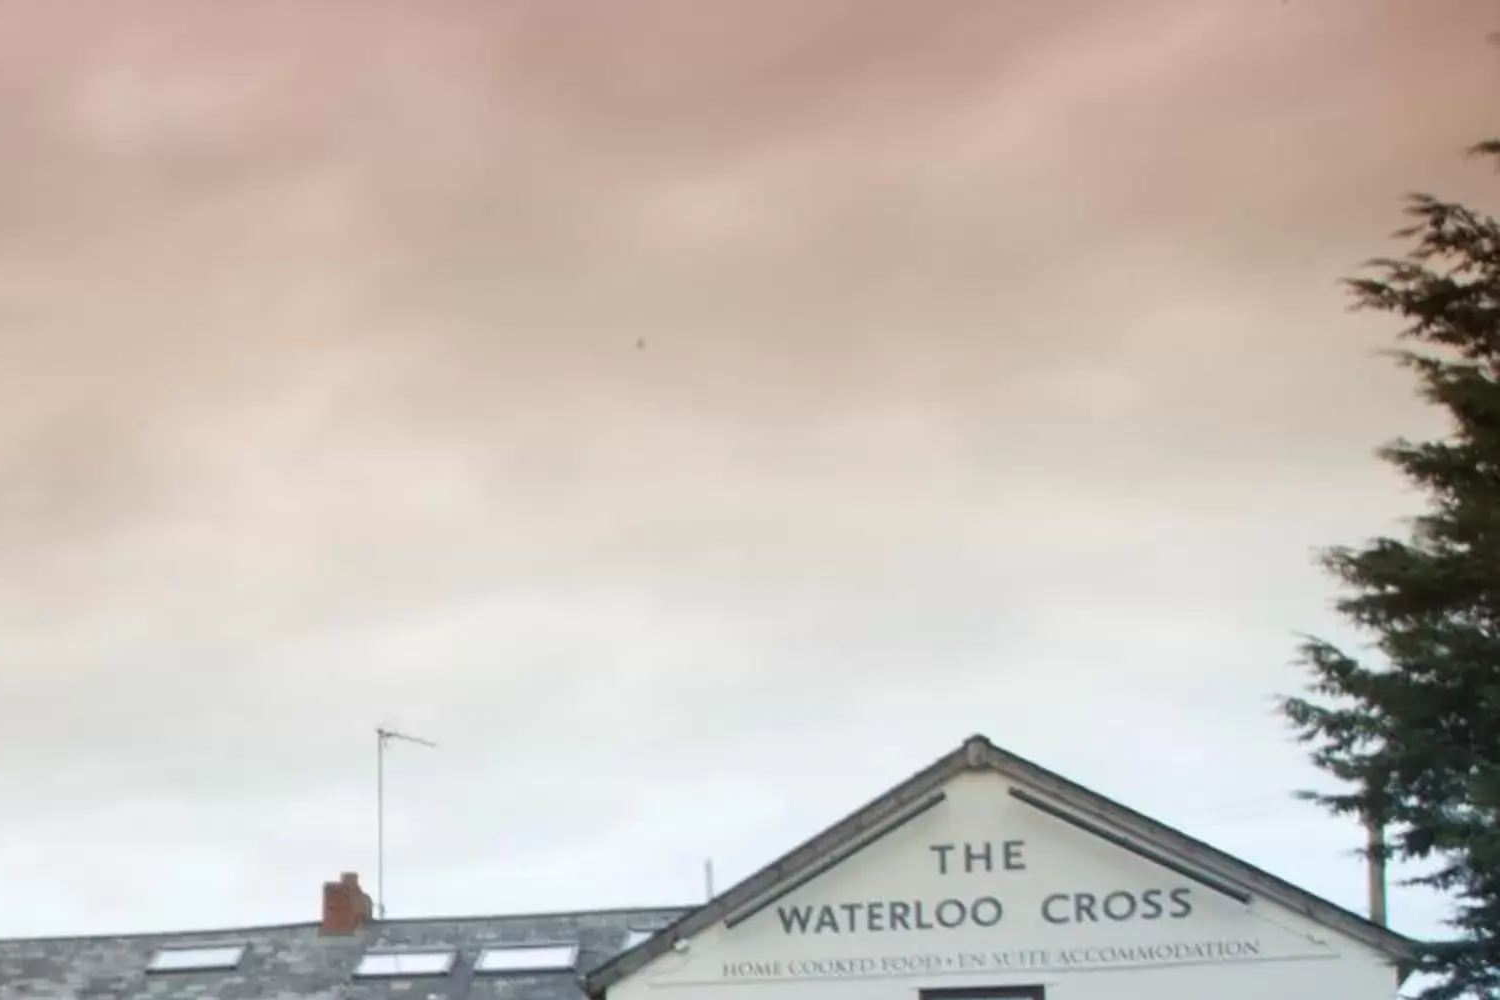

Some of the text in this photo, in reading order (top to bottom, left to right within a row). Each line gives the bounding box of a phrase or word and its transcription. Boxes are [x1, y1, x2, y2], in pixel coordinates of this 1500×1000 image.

[929, 840, 1026, 874] THE
[778, 888, 1193, 935] WATERLOO CROSS
[722, 937, 1261, 978] HOME COOKED FOOD EN SUITE ACCOMMODATION
